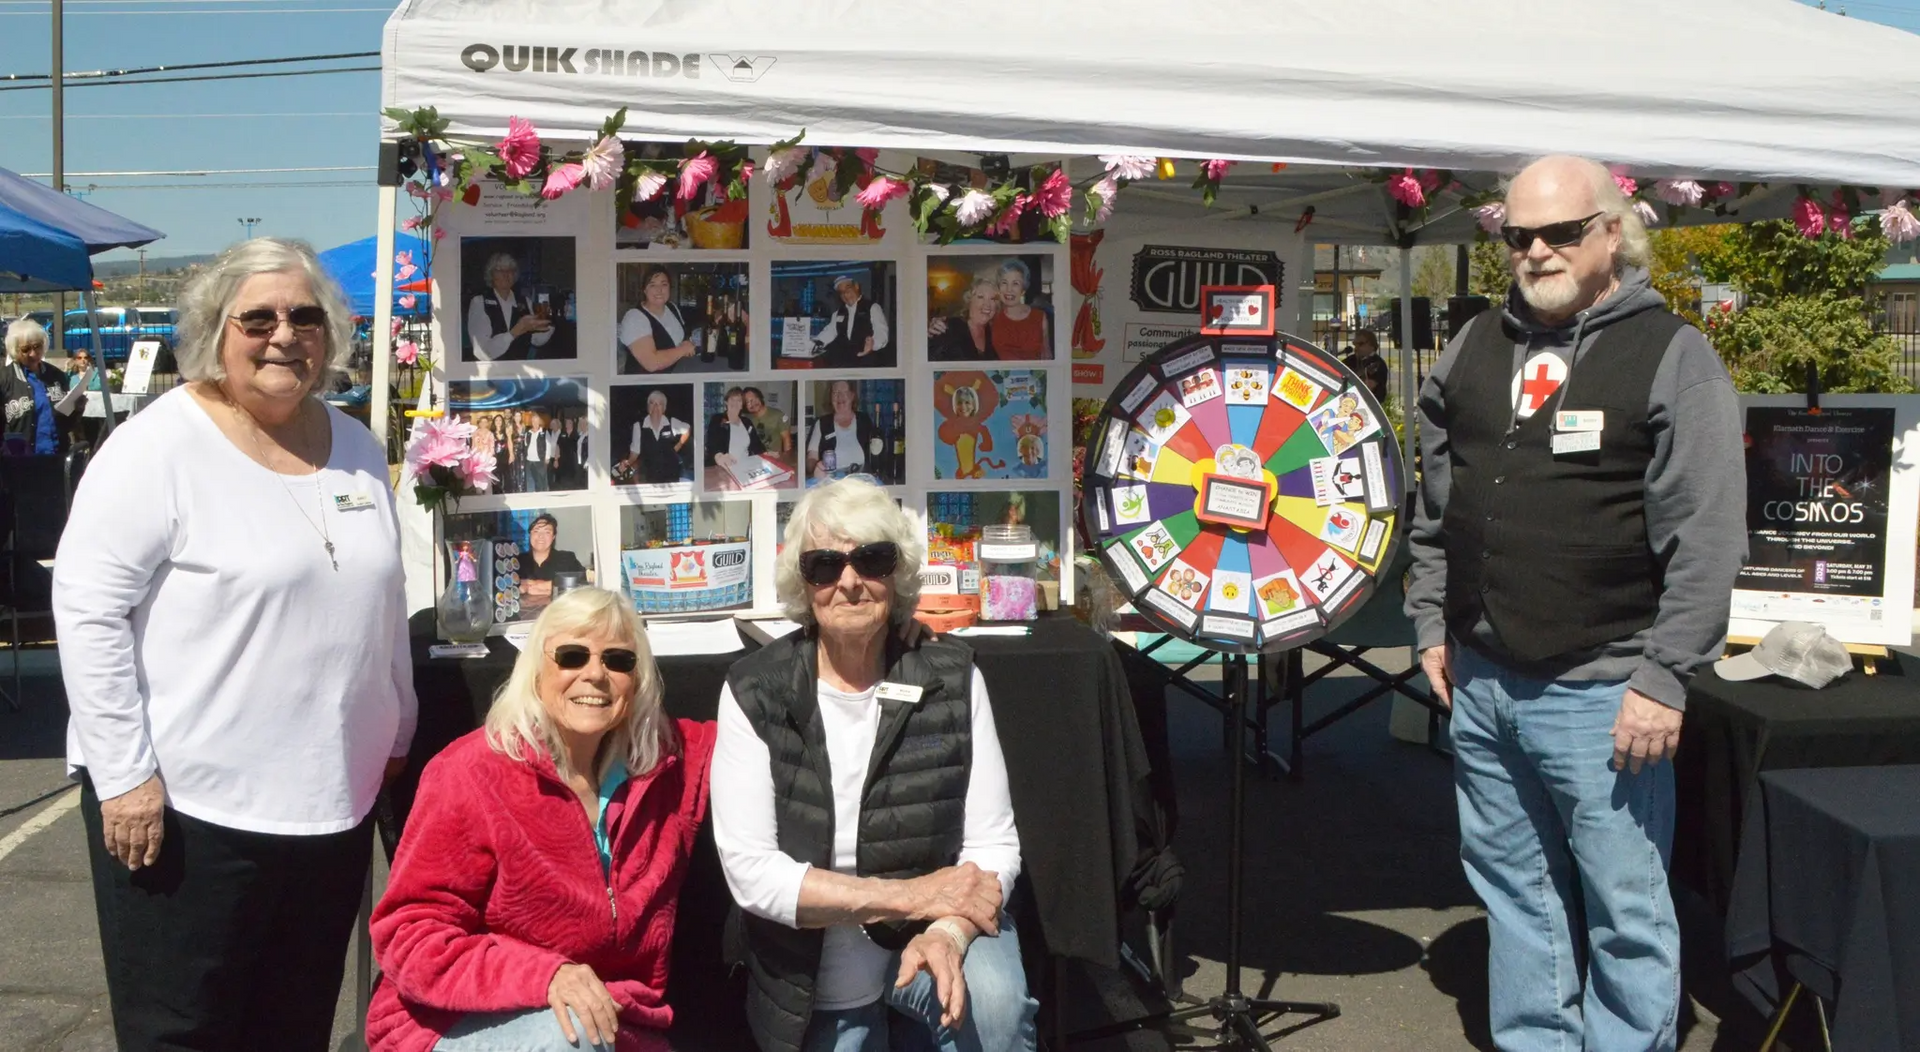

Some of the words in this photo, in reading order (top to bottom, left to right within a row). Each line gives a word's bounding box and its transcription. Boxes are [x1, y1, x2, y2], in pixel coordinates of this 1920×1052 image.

[461, 43, 579, 73] QUIK
[584, 49, 700, 79] SHADE
[1150, 249, 1176, 257] ROSS
[1178, 250, 1223, 259] RAGLAND
[1226, 252, 1268, 261] THEATER
[1127, 340, 1167, 349] passionat
[1286, 375, 1312, 399] THINK
[1790, 453, 1843, 474] INTO
[1797, 476, 1834, 498] THE
[1764, 500, 1864, 523] COSMOS
[714, 552, 744, 566] GUILD
[1815, 562, 1824, 581] 2025
